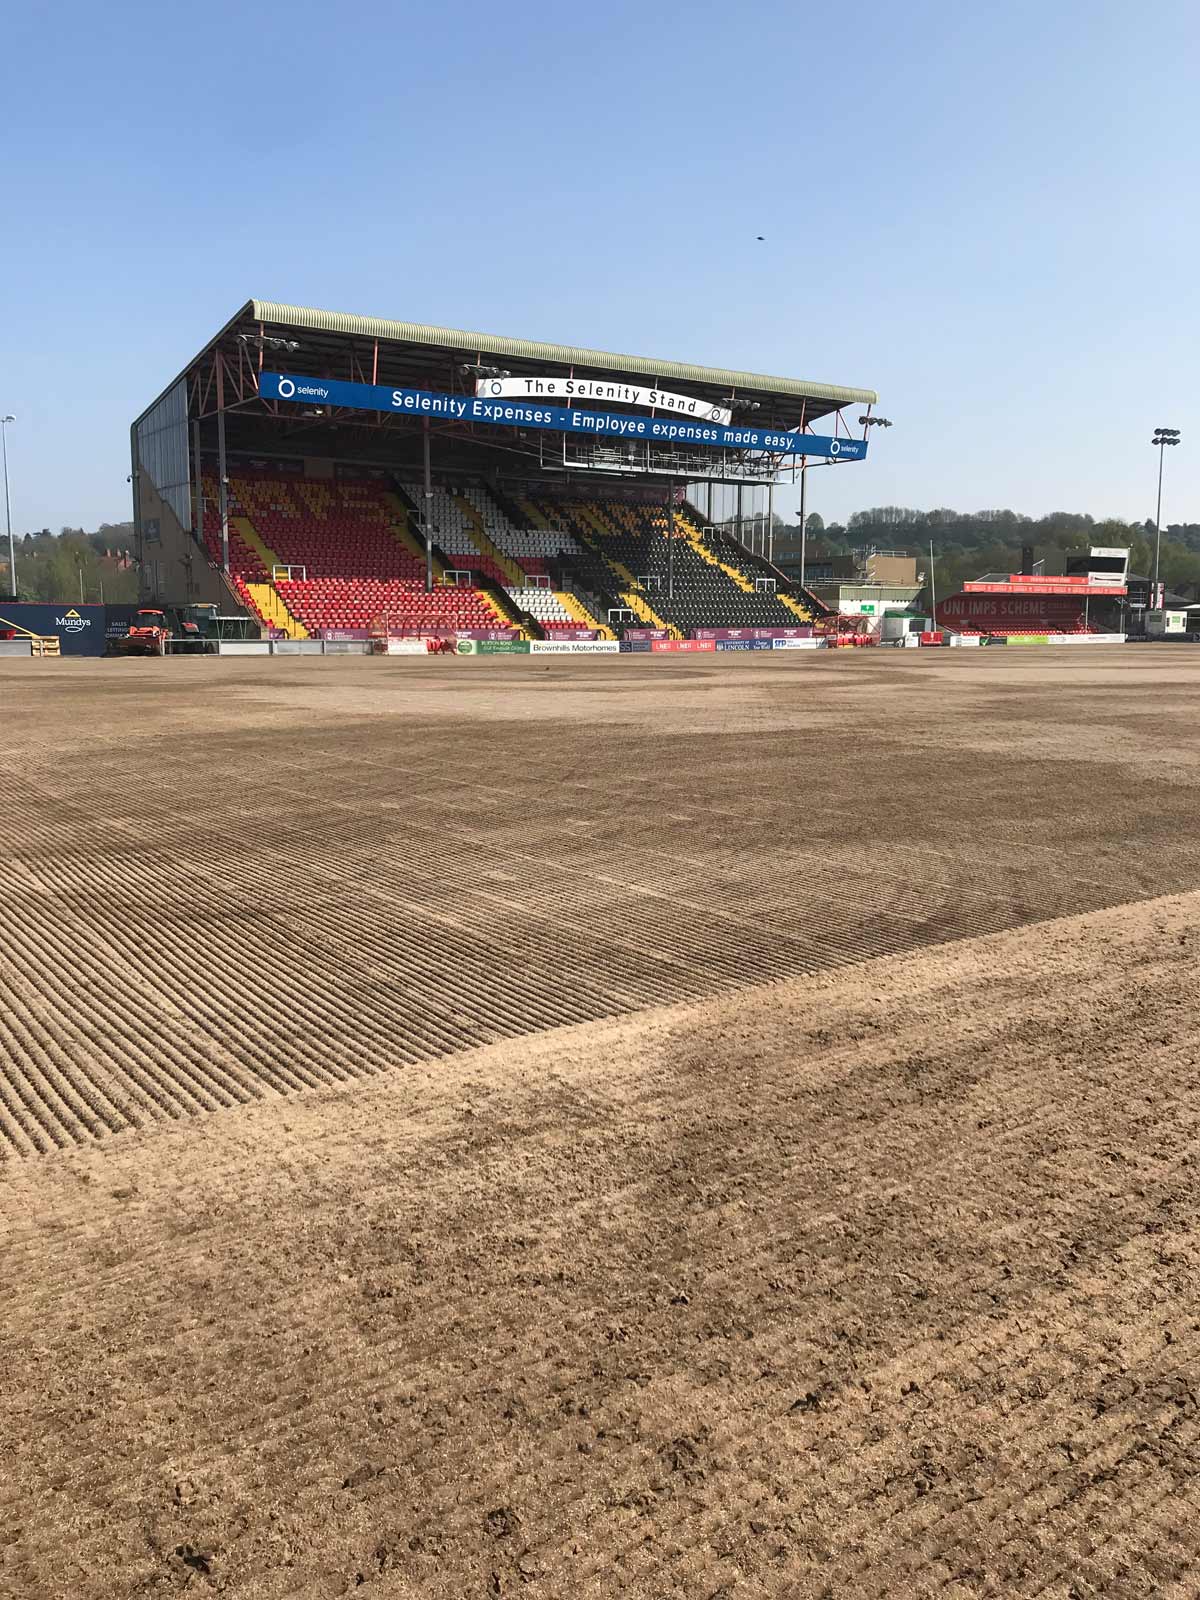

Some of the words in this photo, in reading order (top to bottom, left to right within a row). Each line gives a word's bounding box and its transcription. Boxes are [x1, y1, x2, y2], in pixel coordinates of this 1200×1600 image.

[297, 386, 329, 399] selenity
[525, 380, 556, 394] The
[566, 381, 640, 404] Selenity
[648, 391, 697, 413] Stand
[392, 391, 466, 417] Selenity
[472, 401, 552, 423] Expenses
[572, 412, 646, 433] Employee
[652, 423, 718, 441] expenses
[723, 430, 758, 445] made
[764, 436, 795, 449] easy.
[944, 602, 965, 615] UNI
[968, 601, 997, 615] IMPS
[1001, 602, 1046, 615] SCHEME
[55, 617, 91, 629] Mundys
